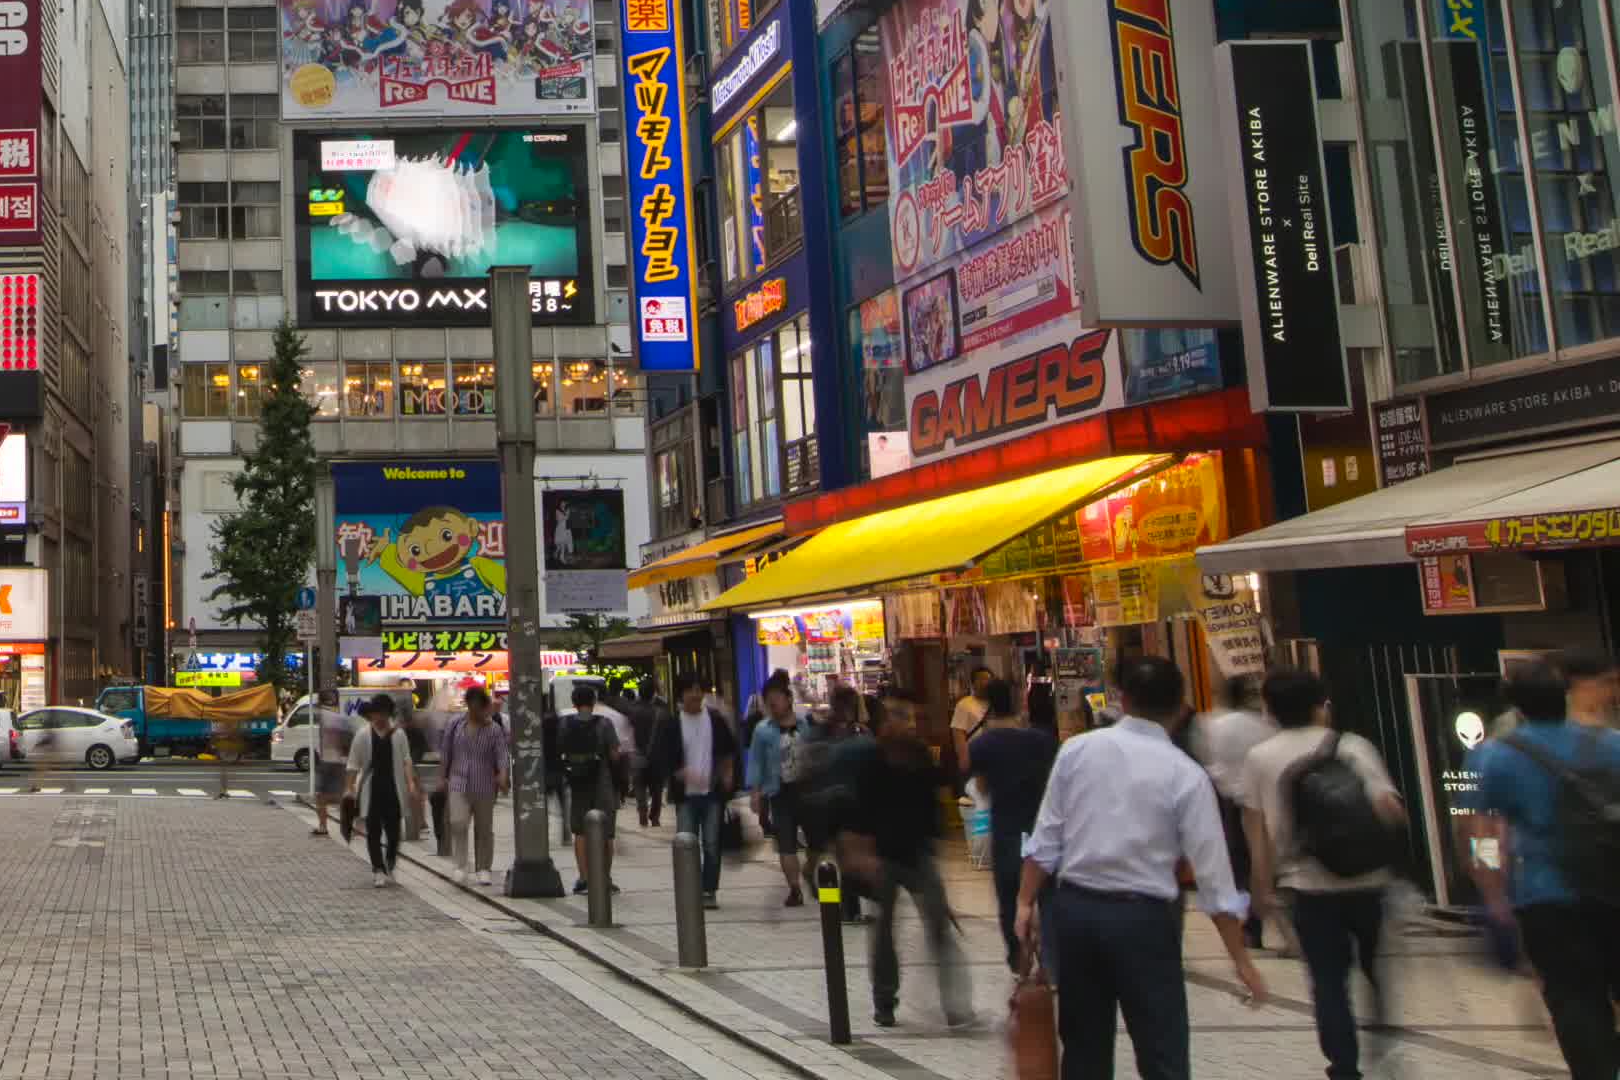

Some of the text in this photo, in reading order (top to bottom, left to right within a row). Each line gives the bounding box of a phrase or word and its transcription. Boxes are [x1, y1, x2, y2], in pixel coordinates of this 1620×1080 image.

[451, 78, 493, 100] LIVE
[938, 69, 970, 120] LIVE
[627, 46, 680, 284] マツモトキヨシ
[1248, 107, 1285, 342] ALIENWARE STORE AKIBA
[1298, 174, 1319, 272] Dell Real Site
[315, 288, 488, 313] TOKYO MX
[910, 328, 1114, 439] GAMERS
[1441, 402, 1506, 425] ALIENWARE
[1510, 392, 1550, 411] STORE
[1553, 384, 1593, 404] AKIBA
[383, 466, 466, 481] Welcome to
